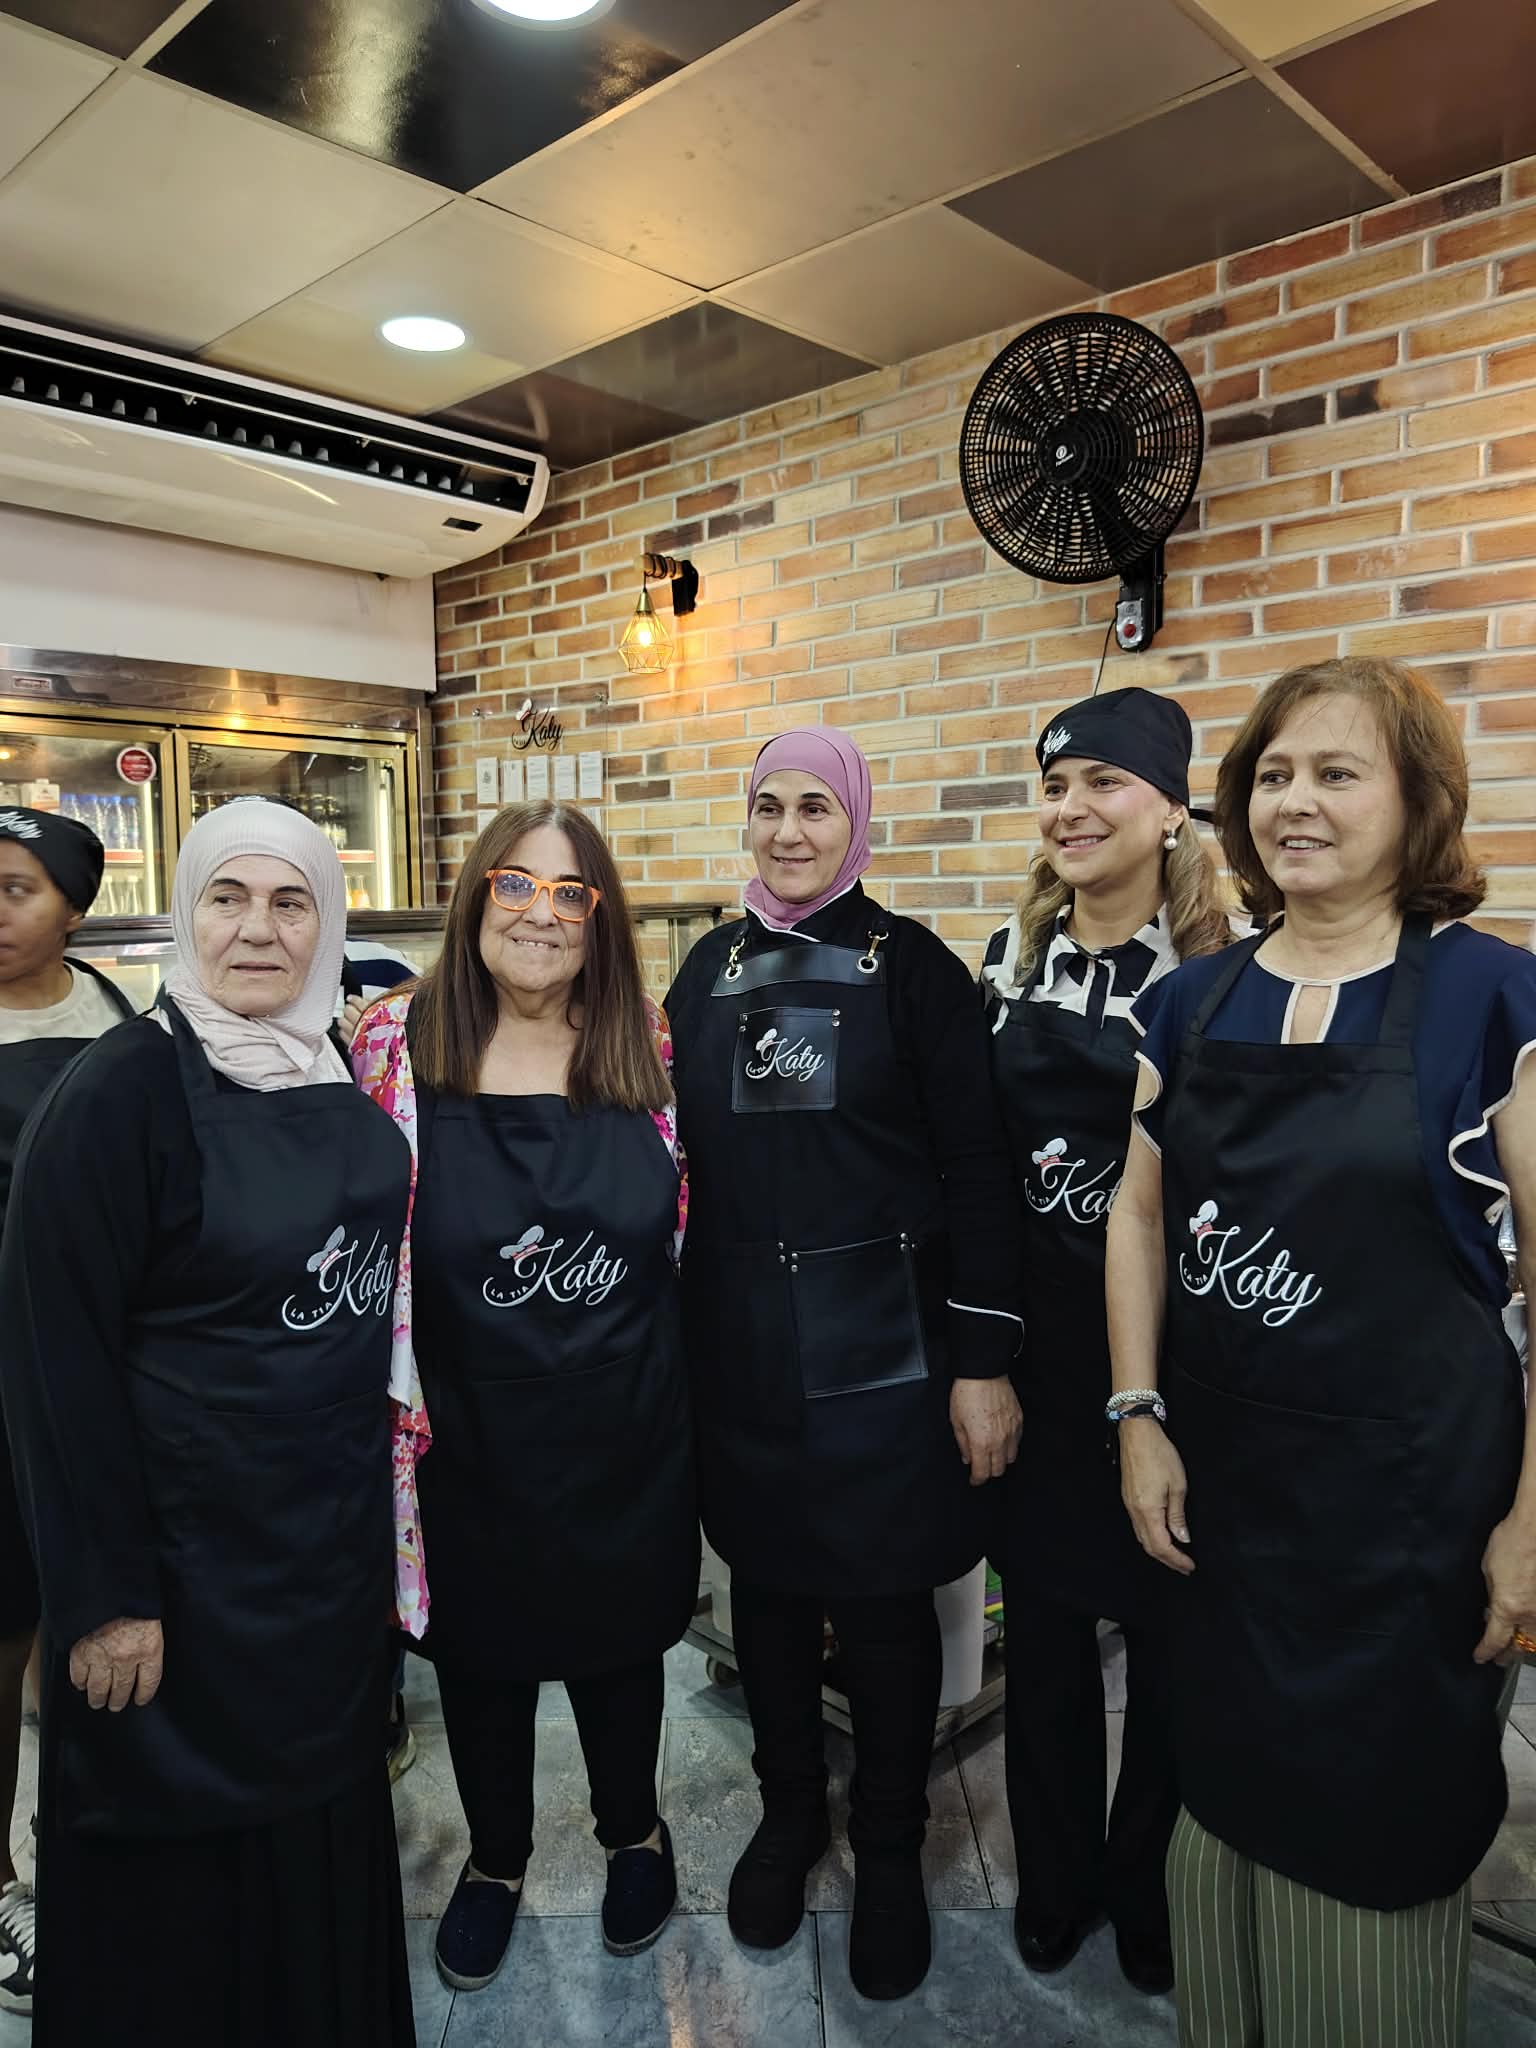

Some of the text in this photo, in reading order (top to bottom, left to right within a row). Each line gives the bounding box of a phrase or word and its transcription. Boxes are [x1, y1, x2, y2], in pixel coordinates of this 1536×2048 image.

[511, 703, 563, 751] Katy
[745, 1037, 825, 1082] Katy
[1024, 1158, 1123, 1231] Kat
[281, 1228, 396, 1331] Katy
[482, 1229, 629, 1307] Katy
[490, 1285, 530, 1300] LA TIA
[1179, 1225, 1323, 1327] Katy
[290, 1301, 333, 1321] LA TIA
